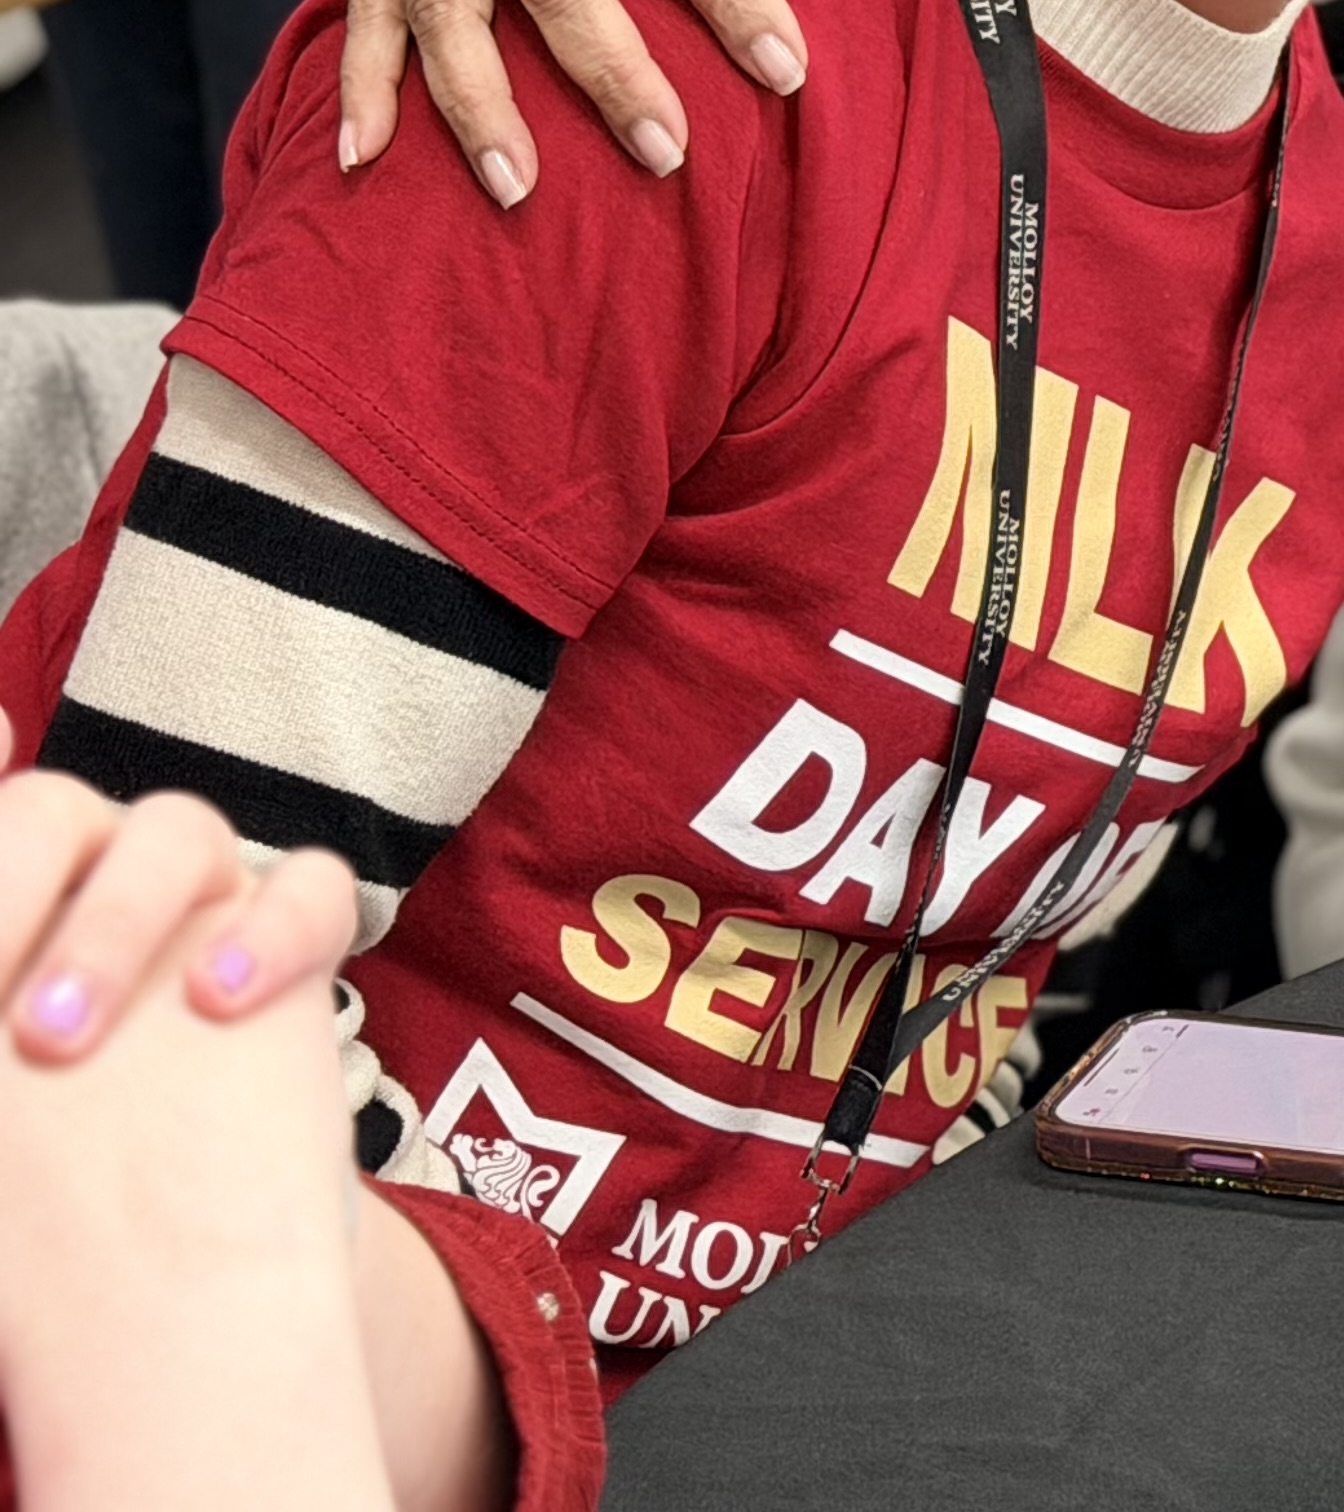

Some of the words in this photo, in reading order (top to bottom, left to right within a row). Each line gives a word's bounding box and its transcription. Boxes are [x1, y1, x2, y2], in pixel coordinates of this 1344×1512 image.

[1005, 172, 1026, 352] UNIVERSITY
[1020, 201, 1041, 325] MOLLOY
[887, 315, 1296, 728] MLK
[978, 489, 1011, 666] UNIVERSITY
[996, 517, 1021, 638] MOLLOY
[689, 698, 1046, 939] DAY
[559, 873, 1029, 1109] SERVICE
[611, 1198, 792, 1294] MOL
